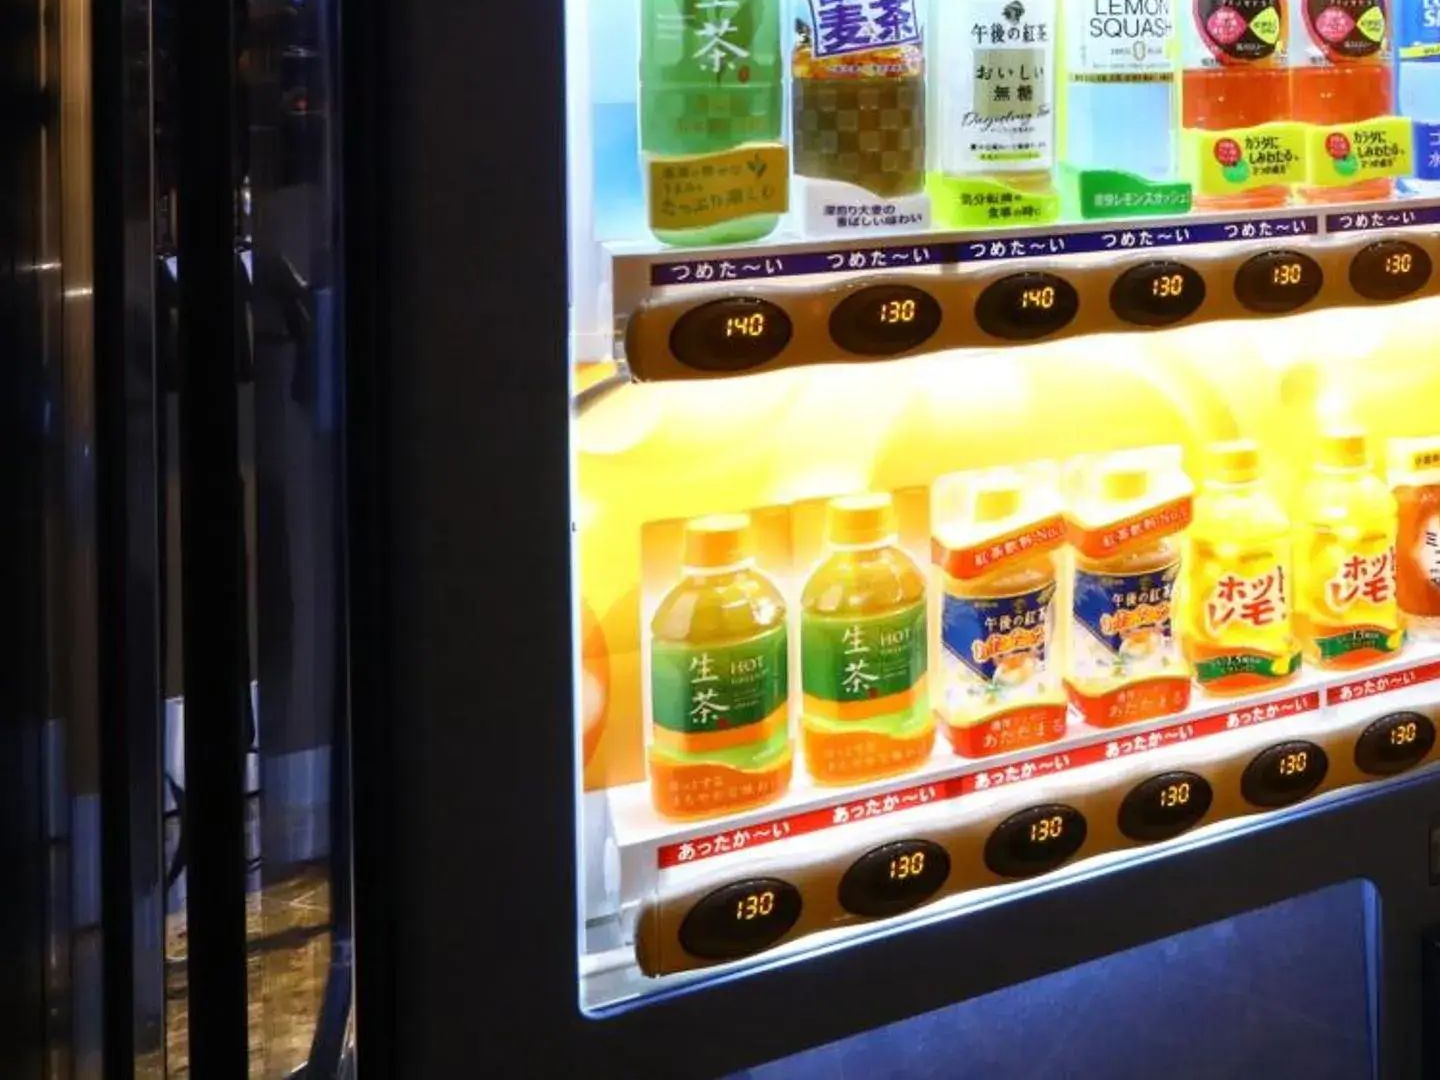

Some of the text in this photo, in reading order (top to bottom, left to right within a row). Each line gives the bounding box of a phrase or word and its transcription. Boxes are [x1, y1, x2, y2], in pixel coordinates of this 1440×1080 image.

[971, 23, 1049, 45] 午後の紅茶
[993, 85, 1033, 102] 無糖
[1273, 263, 1302, 286] 130
[1385, 253, 1413, 274] 130
[1153, 274, 1185, 298] 130
[1022, 287, 1054, 310] 140
[880, 299, 916, 324] 130
[725, 313, 765, 337] 140
[842, 624, 879, 693] 生茶
[689, 653, 730, 724] 生茶
[1390, 722, 1417, 746] 130
[1279, 751, 1307, 776] 130
[1161, 784, 1190, 808] 130
[1030, 815, 1064, 842] 130
[890, 851, 925, 881] 130
[737, 891, 774, 921] 130
